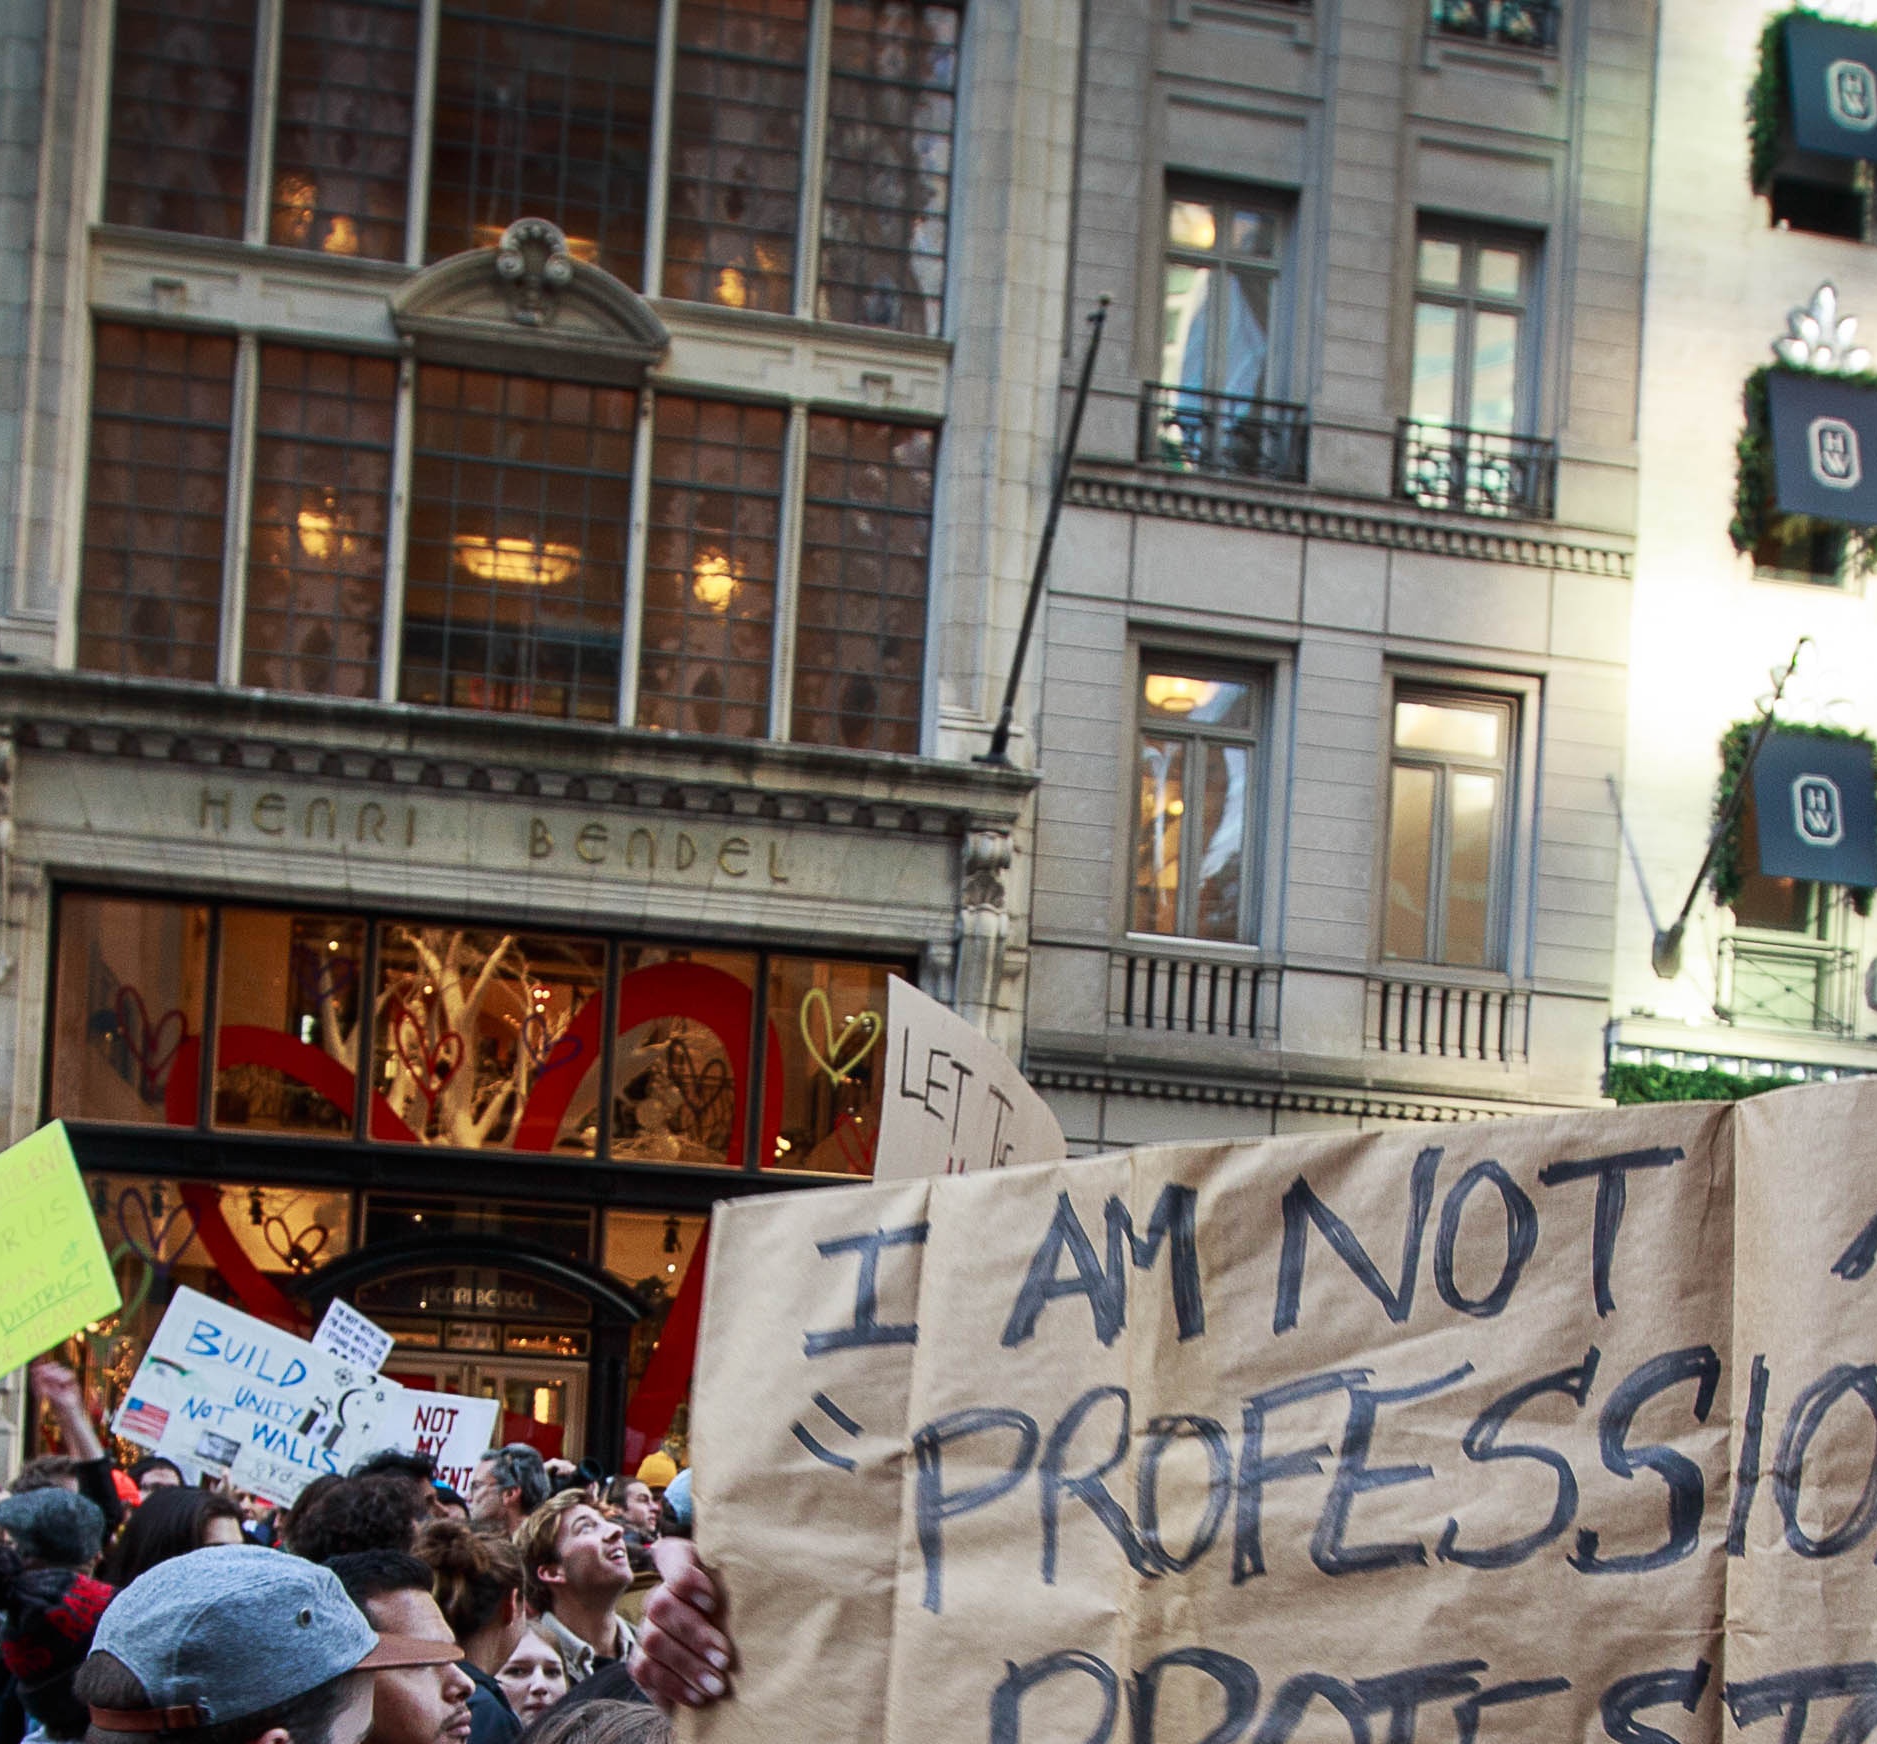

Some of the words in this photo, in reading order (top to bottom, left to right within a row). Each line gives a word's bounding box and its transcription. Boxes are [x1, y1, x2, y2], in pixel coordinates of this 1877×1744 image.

[196, 786, 418, 848] HENRI
[528, 818, 789, 884] BENDEL
[901, 1027, 974, 1146] LET
[26, 1197, 70, 1239] US
[805, 1221, 928, 1357] I
[1002, 1186, 1203, 1347] AM
[1273, 1145, 1684, 1335] NOT
[185, 1320, 307, 1387] BUILD
[180, 1396, 234, 1425] NOT
[252, 1421, 341, 1476] WALLS
[235, 1386, 303, 1426] UNITY
[413, 1405, 459, 1434] NOT
[415, 1436, 447, 1464] MY
